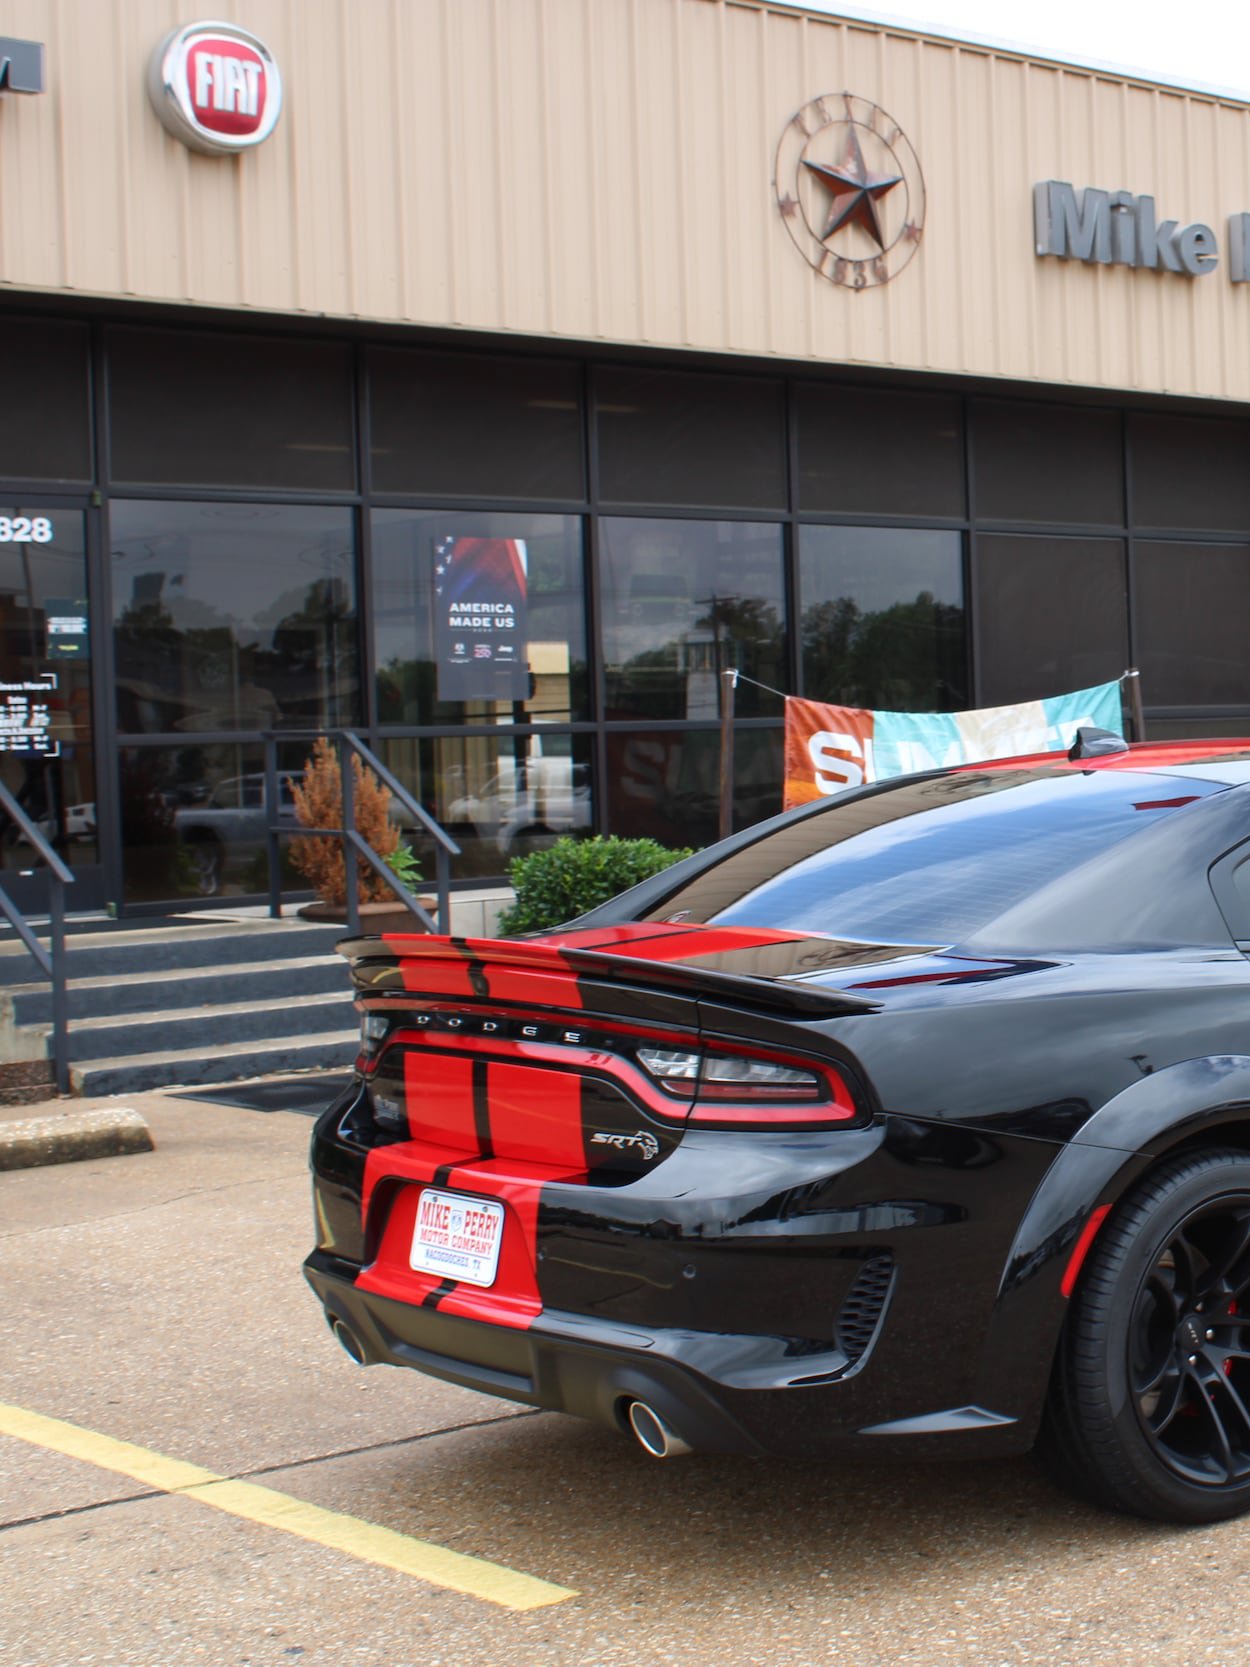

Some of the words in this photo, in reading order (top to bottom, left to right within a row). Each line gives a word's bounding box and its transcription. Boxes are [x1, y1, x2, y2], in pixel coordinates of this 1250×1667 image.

[195, 51, 262, 117] FIAT
[1033, 180, 1218, 277] Mike
[449, 602, 514, 614] AMERICA
[449, 616, 491, 628] MADE
[495, 617, 514, 628] US
[416, 1014, 582, 1044] DODGE
[590, 1132, 644, 1150] SRT
[420, 1200, 451, 1230] MIKE
[463, 1210, 500, 1241] PERRY
[420, 1227, 449, 1246] MOTOR
[451, 1234, 493, 1256] COMPANY
